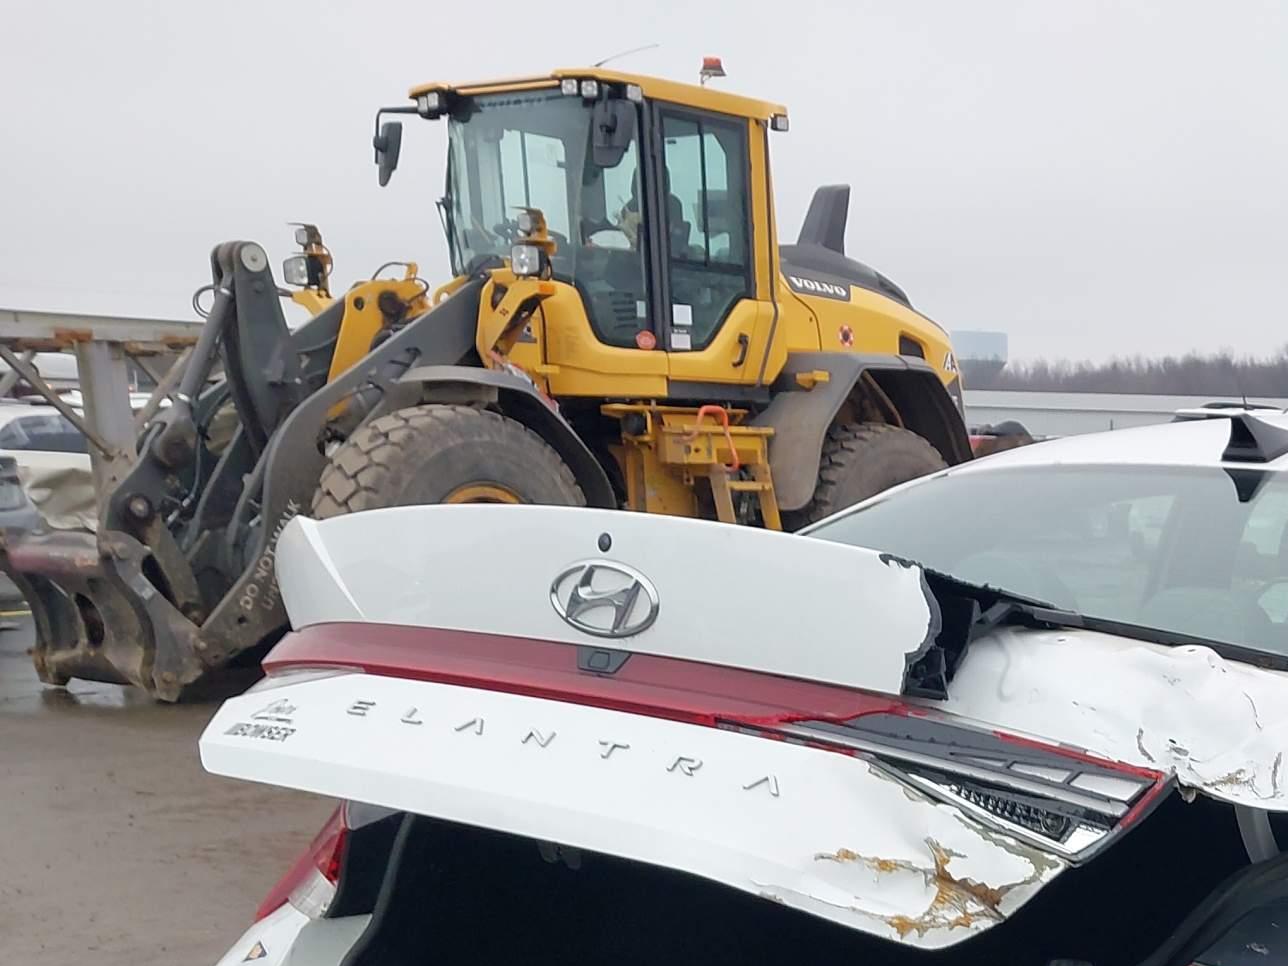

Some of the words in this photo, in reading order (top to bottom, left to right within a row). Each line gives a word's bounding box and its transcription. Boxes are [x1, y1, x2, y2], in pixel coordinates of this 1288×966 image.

[789, 275, 847, 297] VOLVO
[240, 583, 259, 611] DO
[254, 544, 276, 581] NOT
[346, 700, 780, 797] ELANTRA
